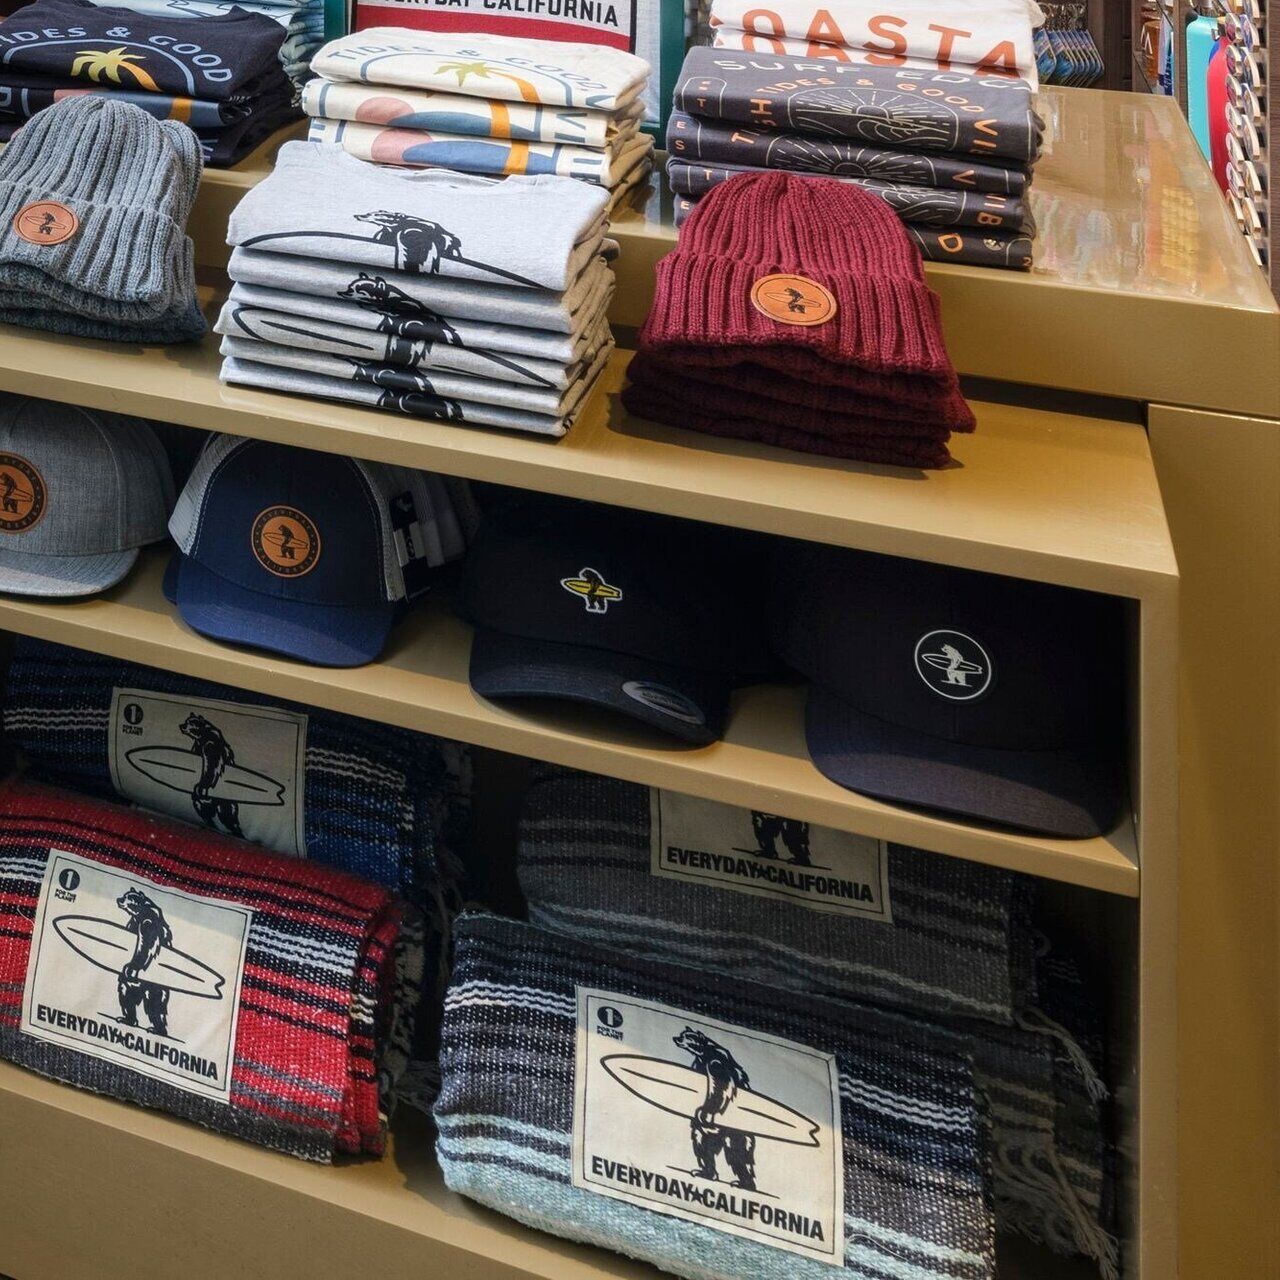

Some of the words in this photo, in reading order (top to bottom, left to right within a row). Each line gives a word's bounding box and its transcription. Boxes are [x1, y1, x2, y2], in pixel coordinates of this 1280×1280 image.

[105, 26, 131, 38] &
[148, 34, 233, 83] GOOD
[327, 44, 435, 61] TIDES
[757, 77, 836, 95] TIDES
[897, 83, 984, 113] GOOD
[667, 847, 759, 877] EVERYDAY
[767, 866, 873, 903] CALIFORNIA
[37, 1004, 118, 1043] EVERYDAY
[124, 1032, 218, 1080] CALIFORNIA
[592, 1156, 696, 1202] EVERYDAY
[702, 1187, 824, 1241] CALIFORNIA
